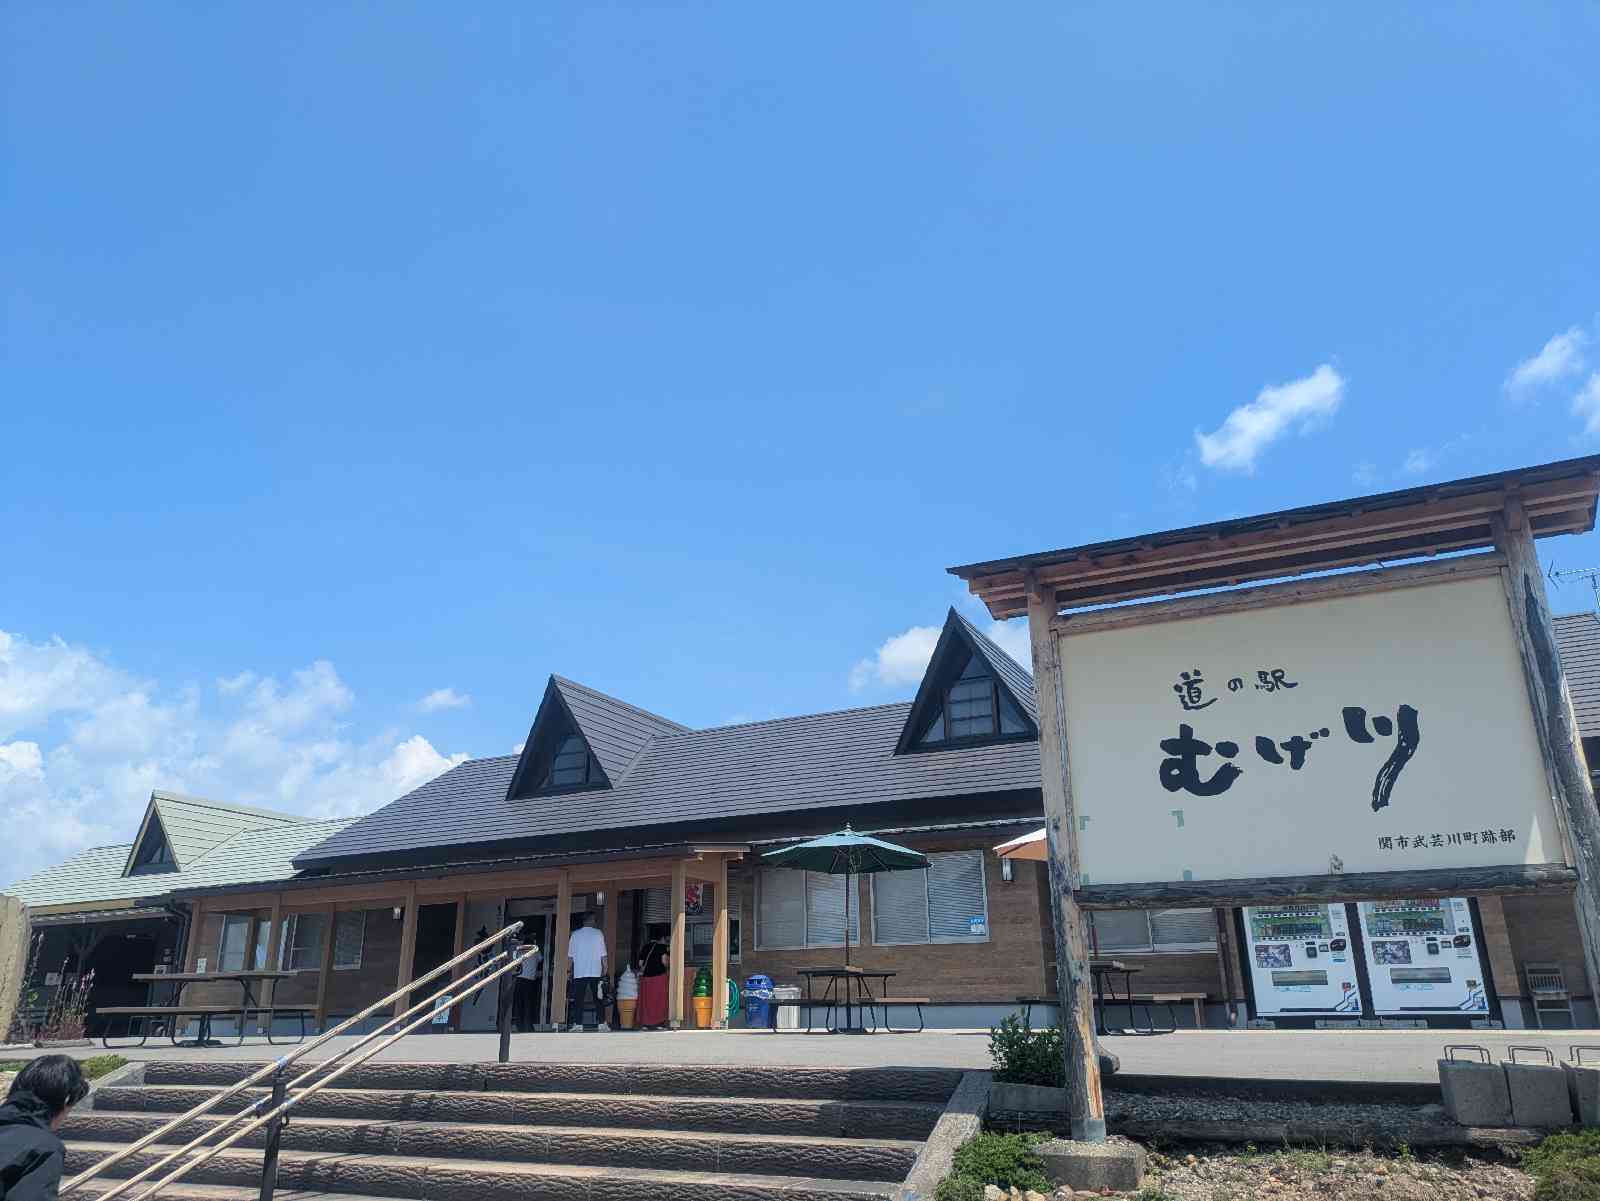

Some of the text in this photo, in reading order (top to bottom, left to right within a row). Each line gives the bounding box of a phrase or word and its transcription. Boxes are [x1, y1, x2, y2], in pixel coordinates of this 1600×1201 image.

[1174, 669, 1298, 710] 道の駅
[1159, 704, 1419, 812] むげ川
